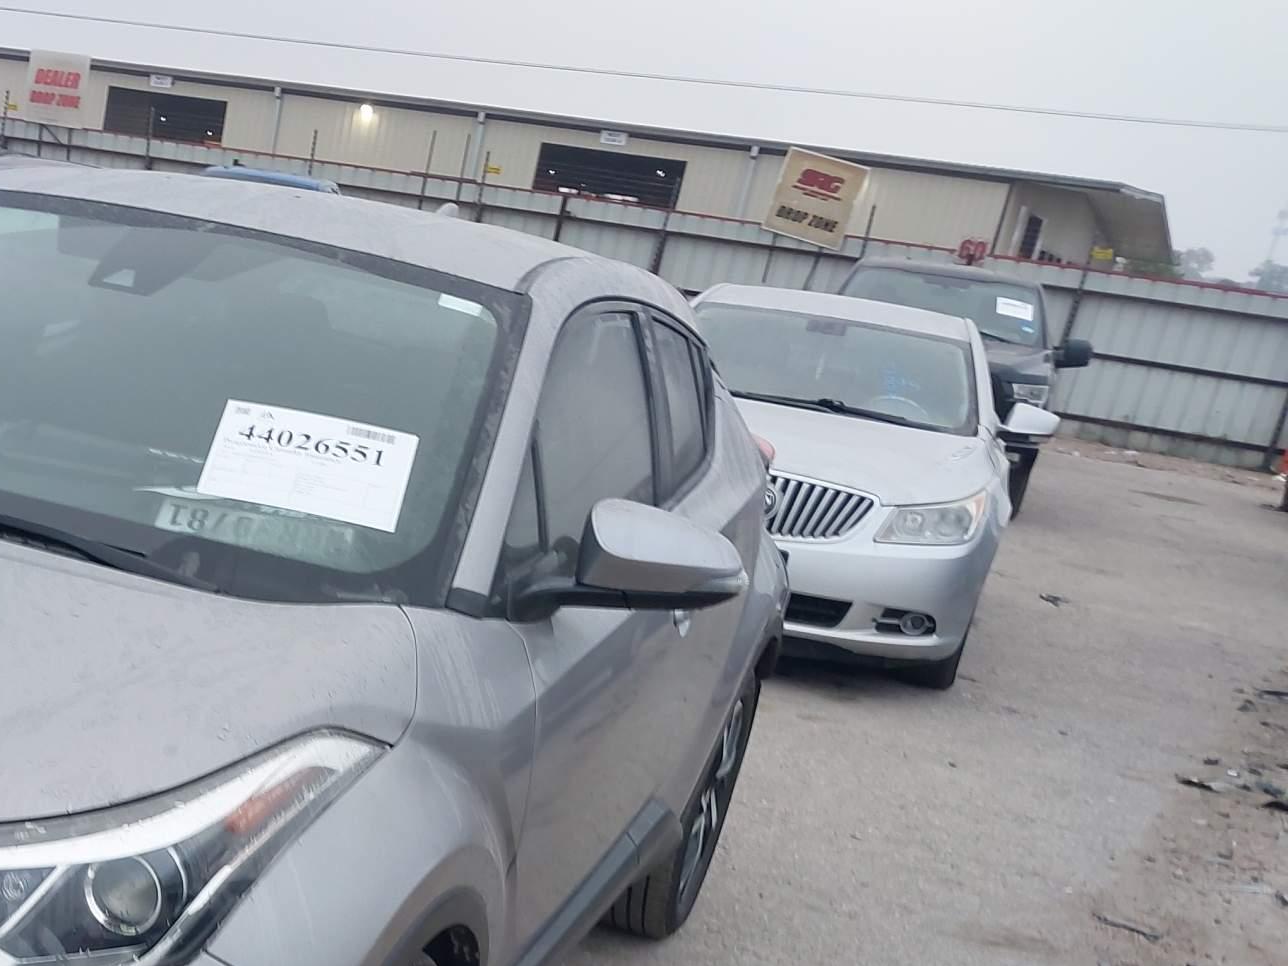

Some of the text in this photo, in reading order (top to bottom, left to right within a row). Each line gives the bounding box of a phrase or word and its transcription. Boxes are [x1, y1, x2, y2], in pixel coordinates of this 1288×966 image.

[34, 68, 81, 89] DEALER
[29, 90, 81, 108] DROP ZONE
[775, 205, 839, 233] DROP ZONE
[238, 424, 385, 467] 44026551
